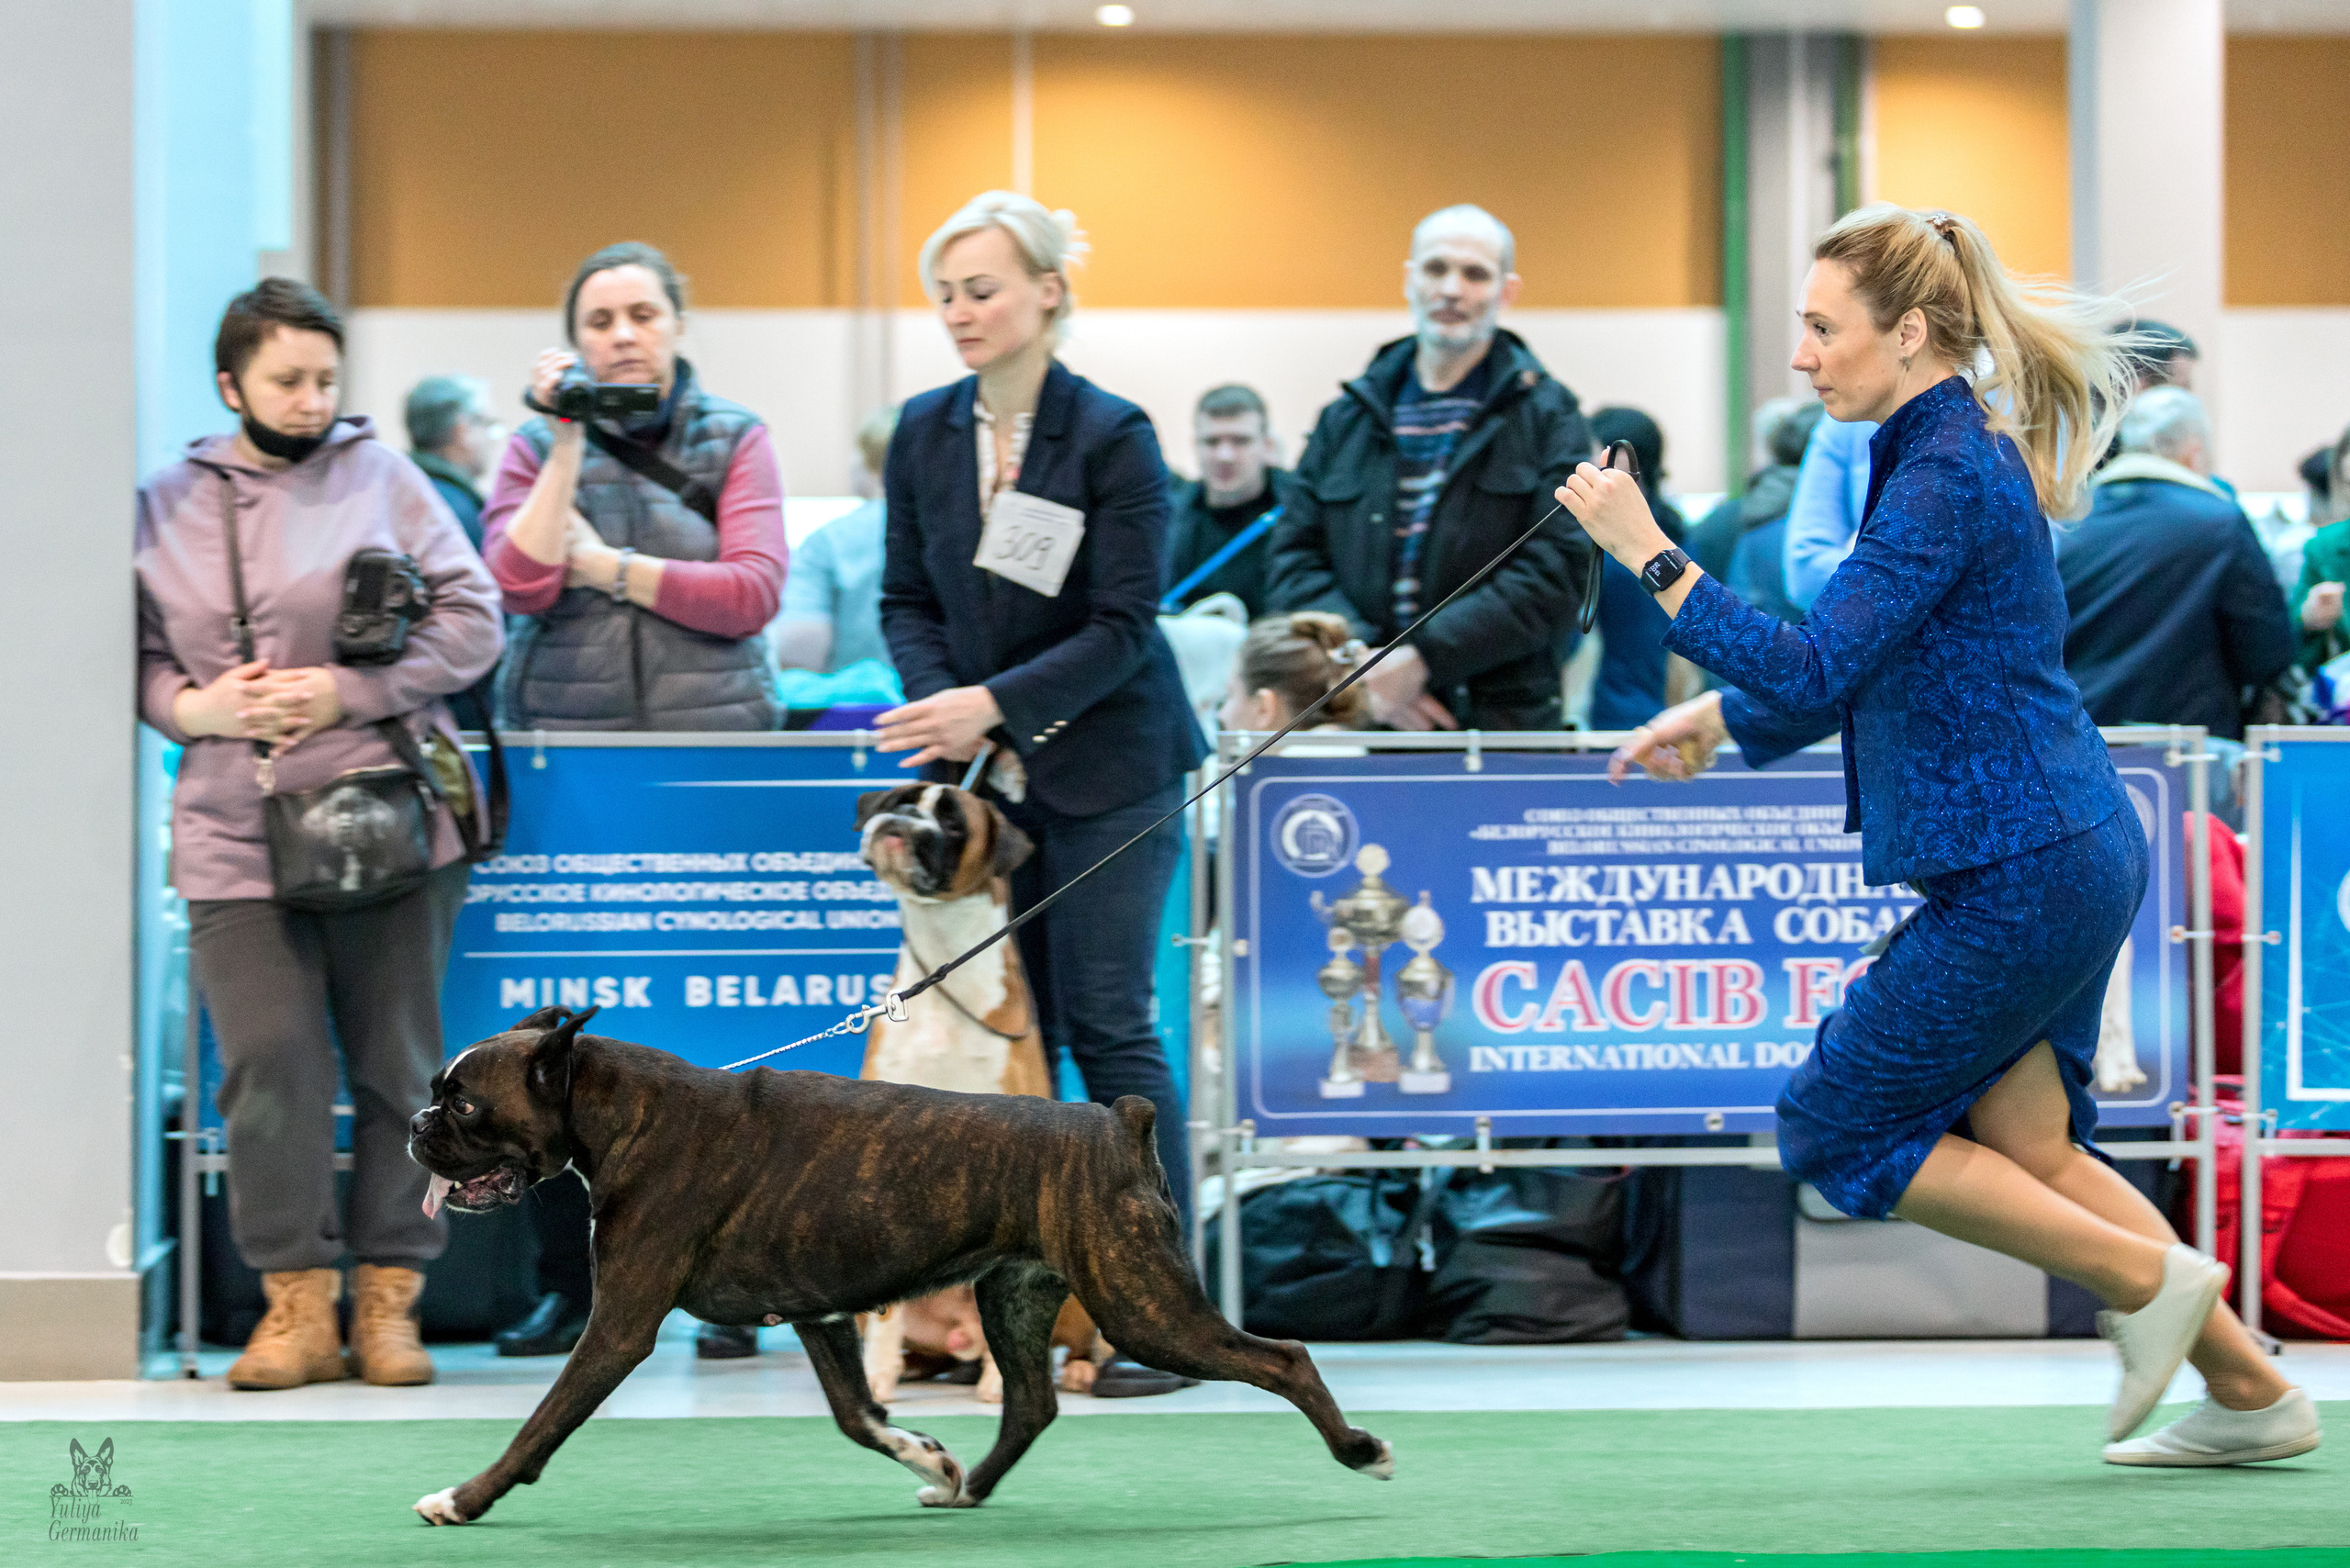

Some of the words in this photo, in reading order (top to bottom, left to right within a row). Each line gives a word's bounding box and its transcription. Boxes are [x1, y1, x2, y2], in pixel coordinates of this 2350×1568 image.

[994, 524, 1054, 570] 309
[1470, 862, 1921, 907] МЕЖДУНАРОДН
[655, 910, 824, 931] CYNOLOGICAL
[1484, 906, 1754, 947] ВЫСТАВКА
[1773, 905, 1918, 945] СОБА
[499, 976, 654, 1009] MINSK
[685, 974, 894, 1007] BELARUS
[1472, 958, 1768, 1033] CACIB
[1783, 956, 1880, 1029] F
[1470, 1043, 1750, 1072] INTERNATIONAL
[1754, 1040, 1815, 1070] DO
